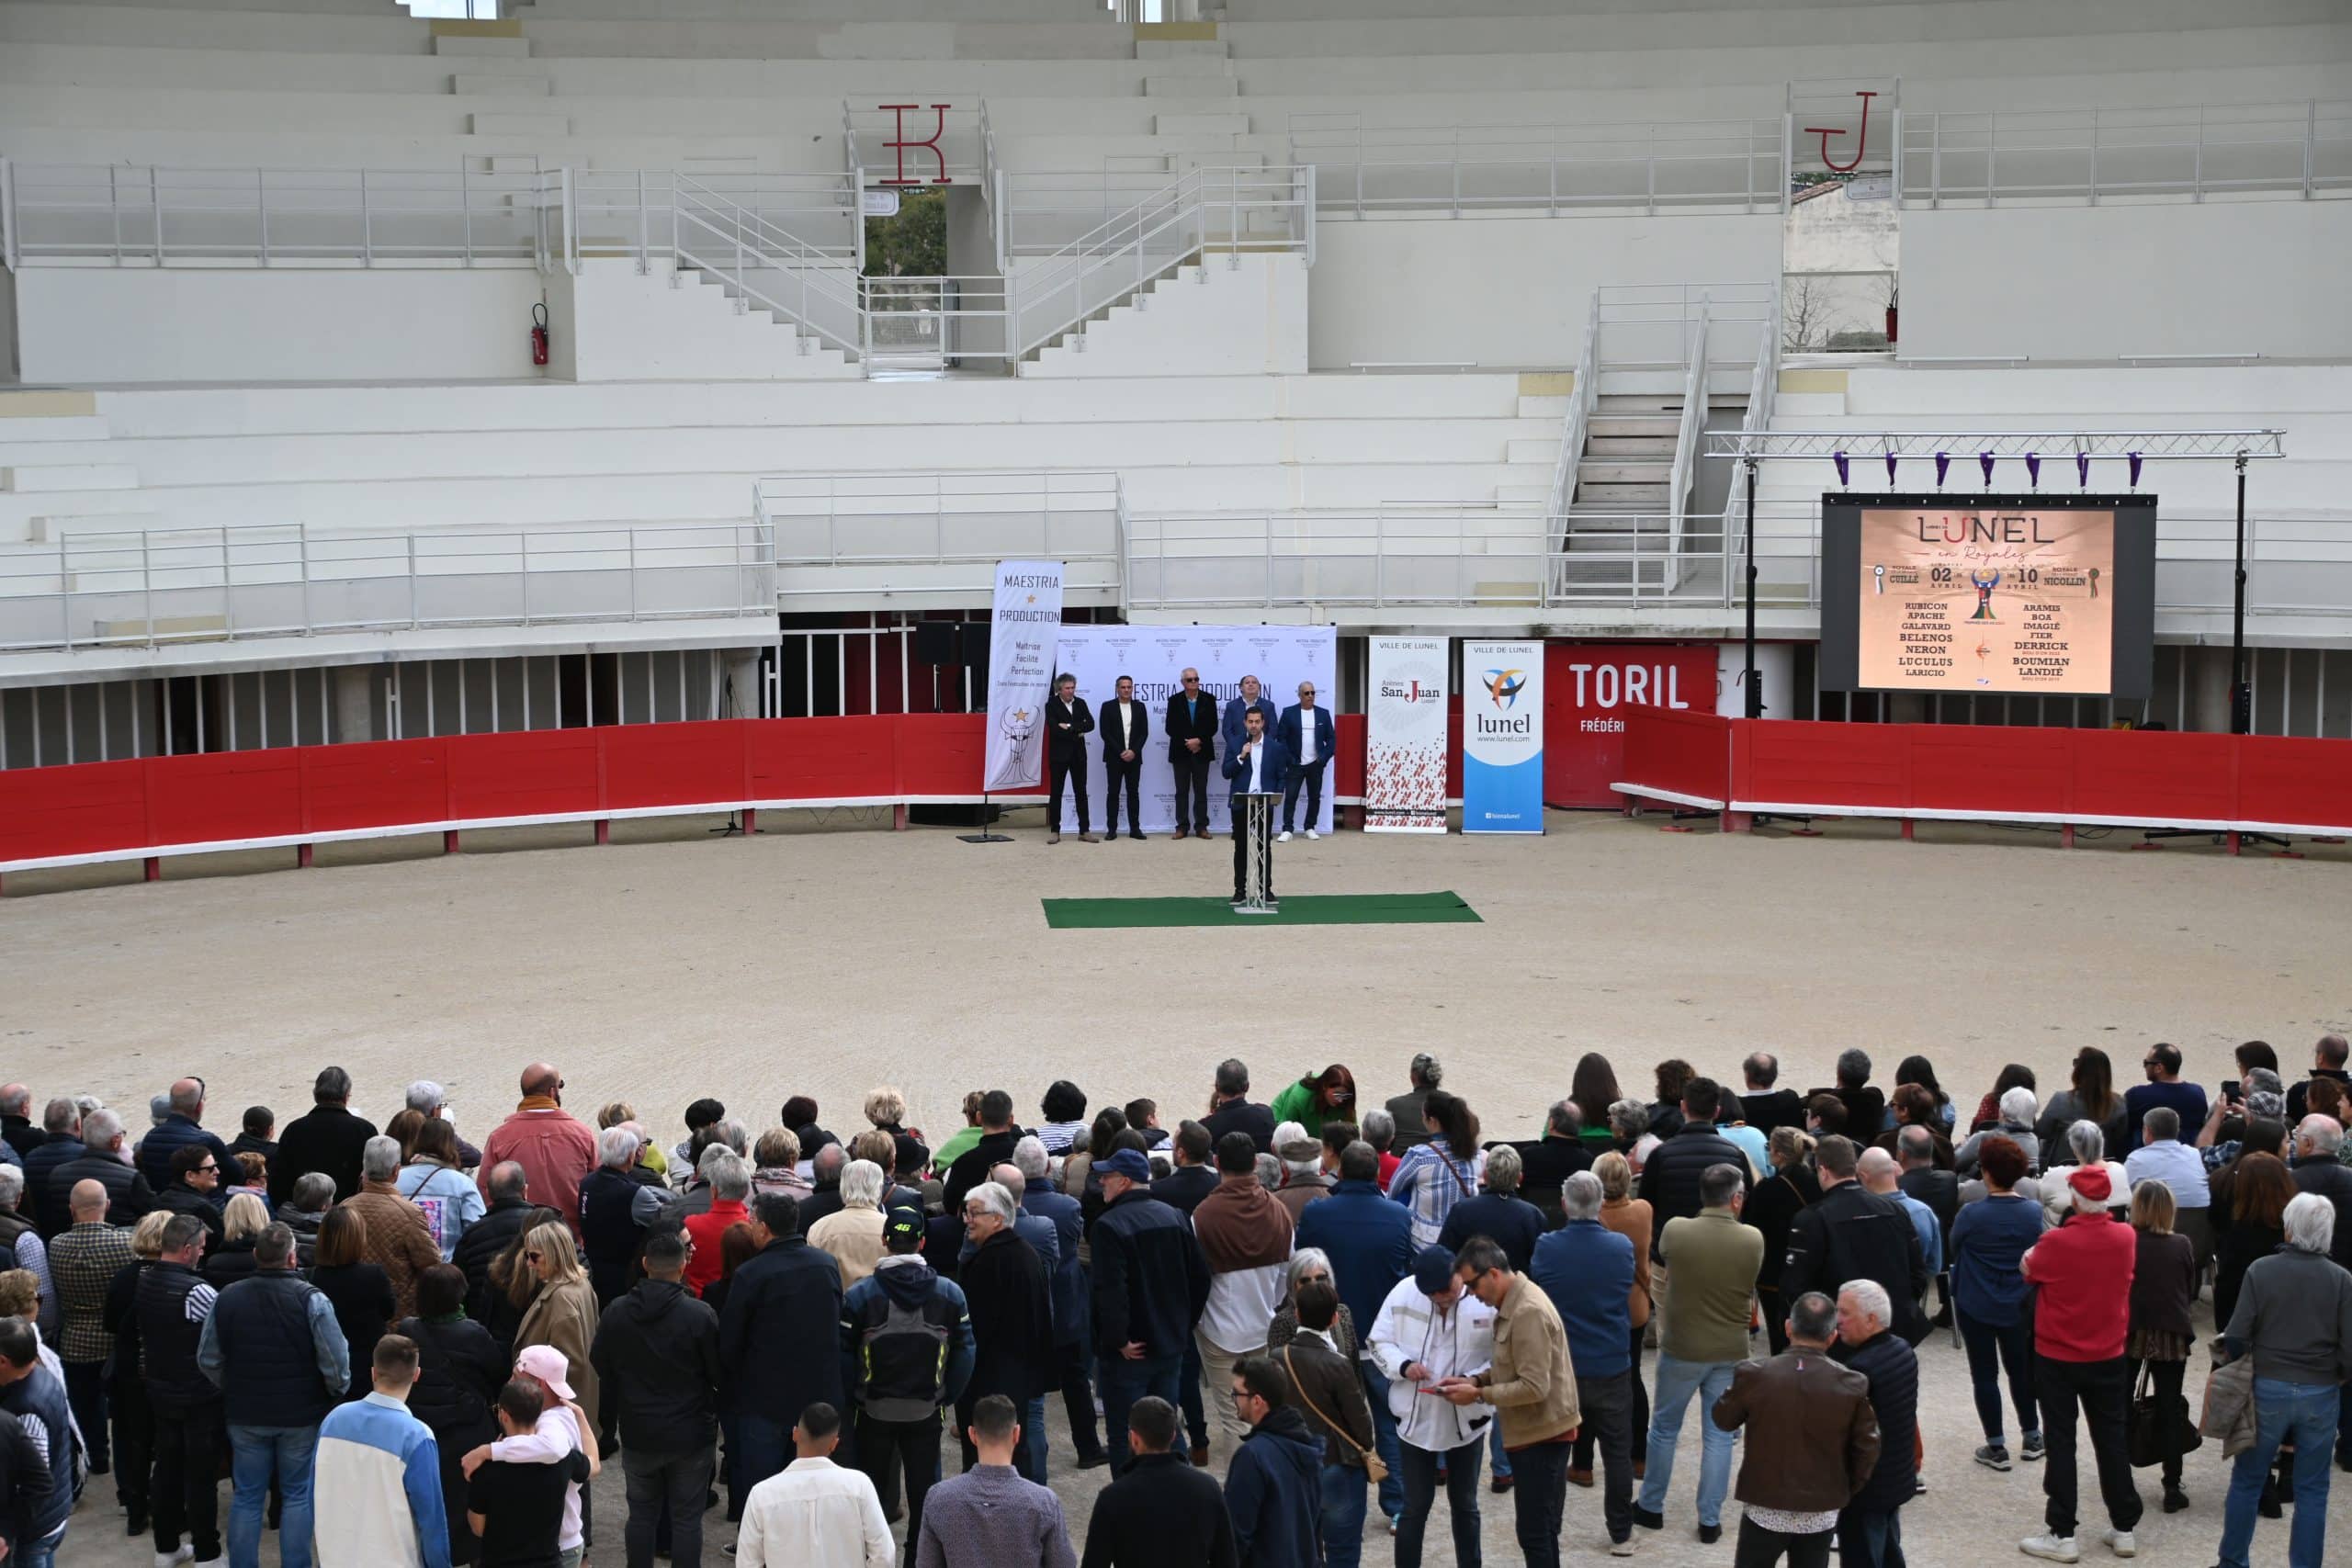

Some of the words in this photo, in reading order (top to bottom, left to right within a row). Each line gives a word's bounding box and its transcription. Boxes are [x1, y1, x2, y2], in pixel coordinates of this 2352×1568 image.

[1804, 91, 1877, 172] J
[878, 104, 952, 184] K
[1917, 516, 2055, 544] LUNEL
[1004, 575, 1059, 589] MAESTRIA
[1931, 568, 1951, 582] 02
[2018, 569, 2038, 583] 10
[2043, 577, 2086, 586] NICOLLIN
[1000, 609, 1060, 623] PRODUCTION
[1899, 633, 1953, 642] BELENOS
[1905, 646, 1947, 654] NERON
[2014, 642, 2069, 650] DERRICK
[1898, 658, 1953, 666] LUCULUS
[2013, 658, 2070, 666] BOUMIAN
[1012, 666, 1044, 675] Perfection
[2018, 667, 2064, 676] LANDIÉ
[1381, 686, 1403, 697] San
[1404, 680, 1441, 703] Juan
[1568, 664, 1689, 708] TORIL
[1477, 713, 1530, 733] lunel
[894, 1223, 911, 1232] 46
